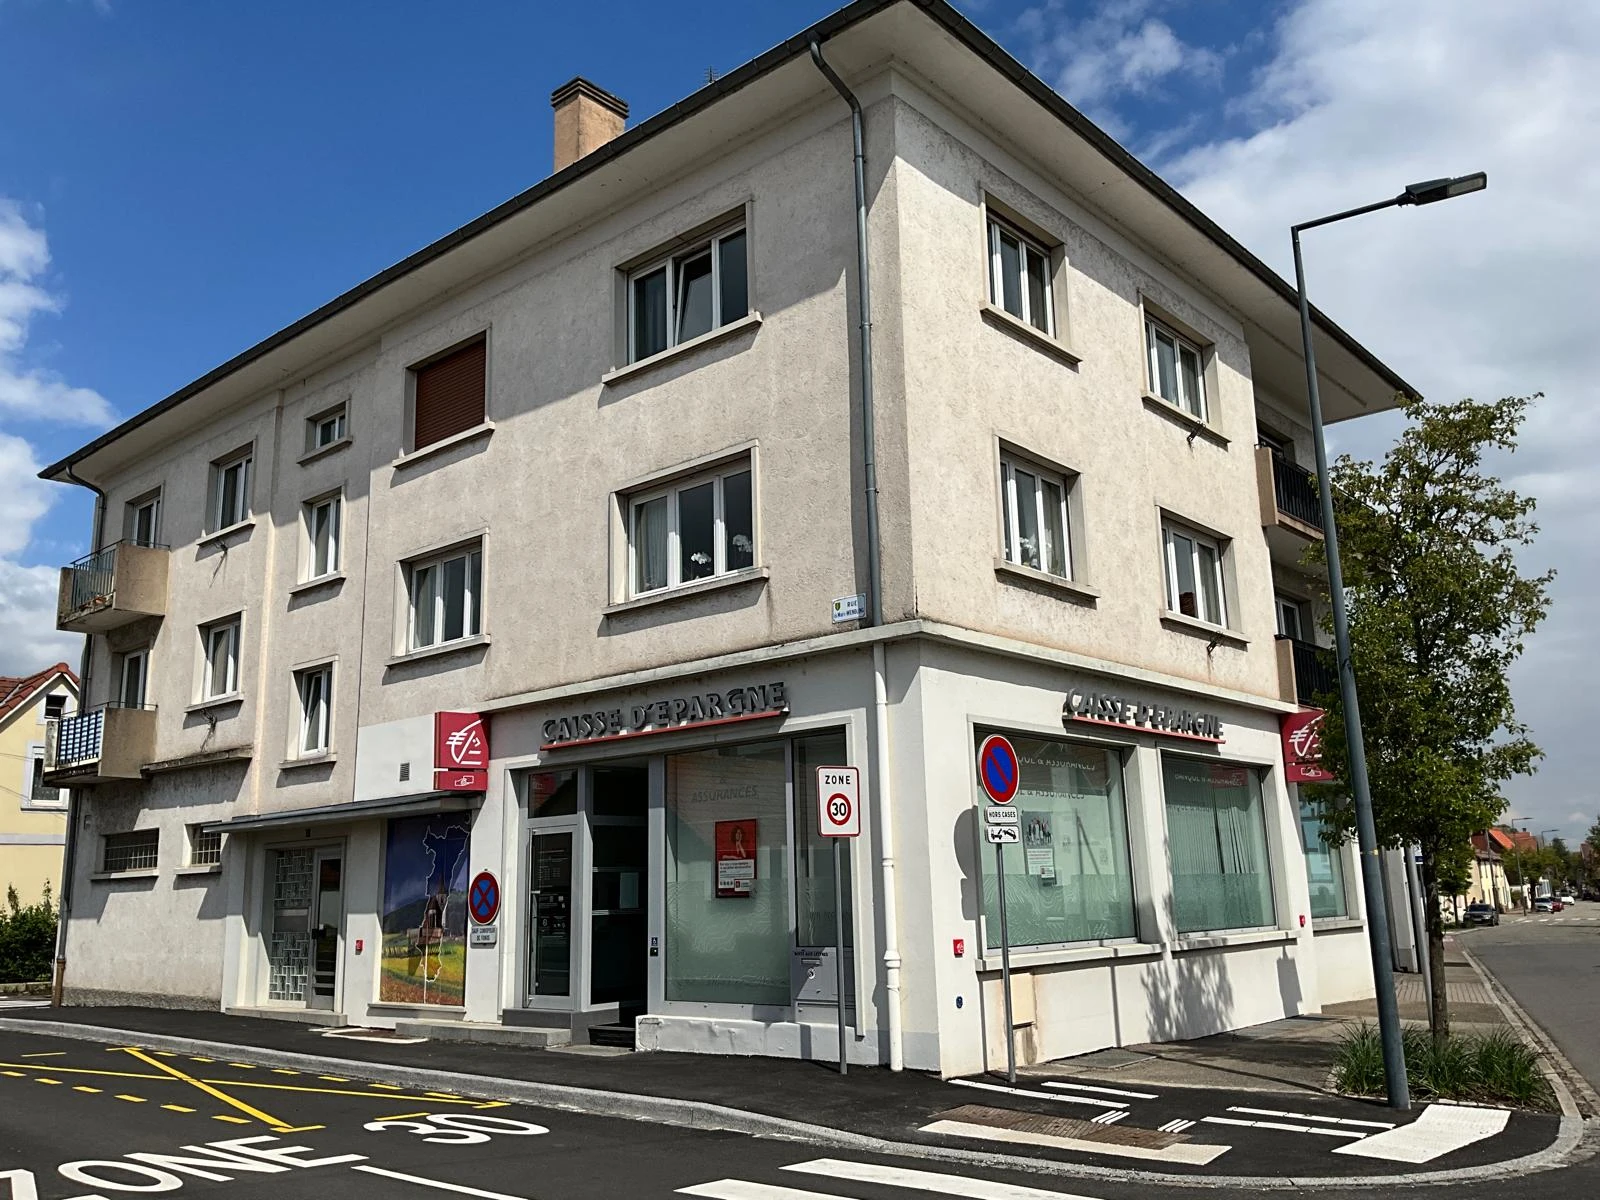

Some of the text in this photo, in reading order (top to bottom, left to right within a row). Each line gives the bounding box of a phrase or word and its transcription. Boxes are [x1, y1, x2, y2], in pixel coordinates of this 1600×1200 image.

[541, 682, 786, 744] CAISSE D'EPARGNE
[1064, 688, 1132, 723] CAISSE
[824, 774, 851, 785] ZONE
[832, 802, 847, 817] 30
[1002, 811, 1016, 819] CASES
[363, 1113, 551, 1145] 30
